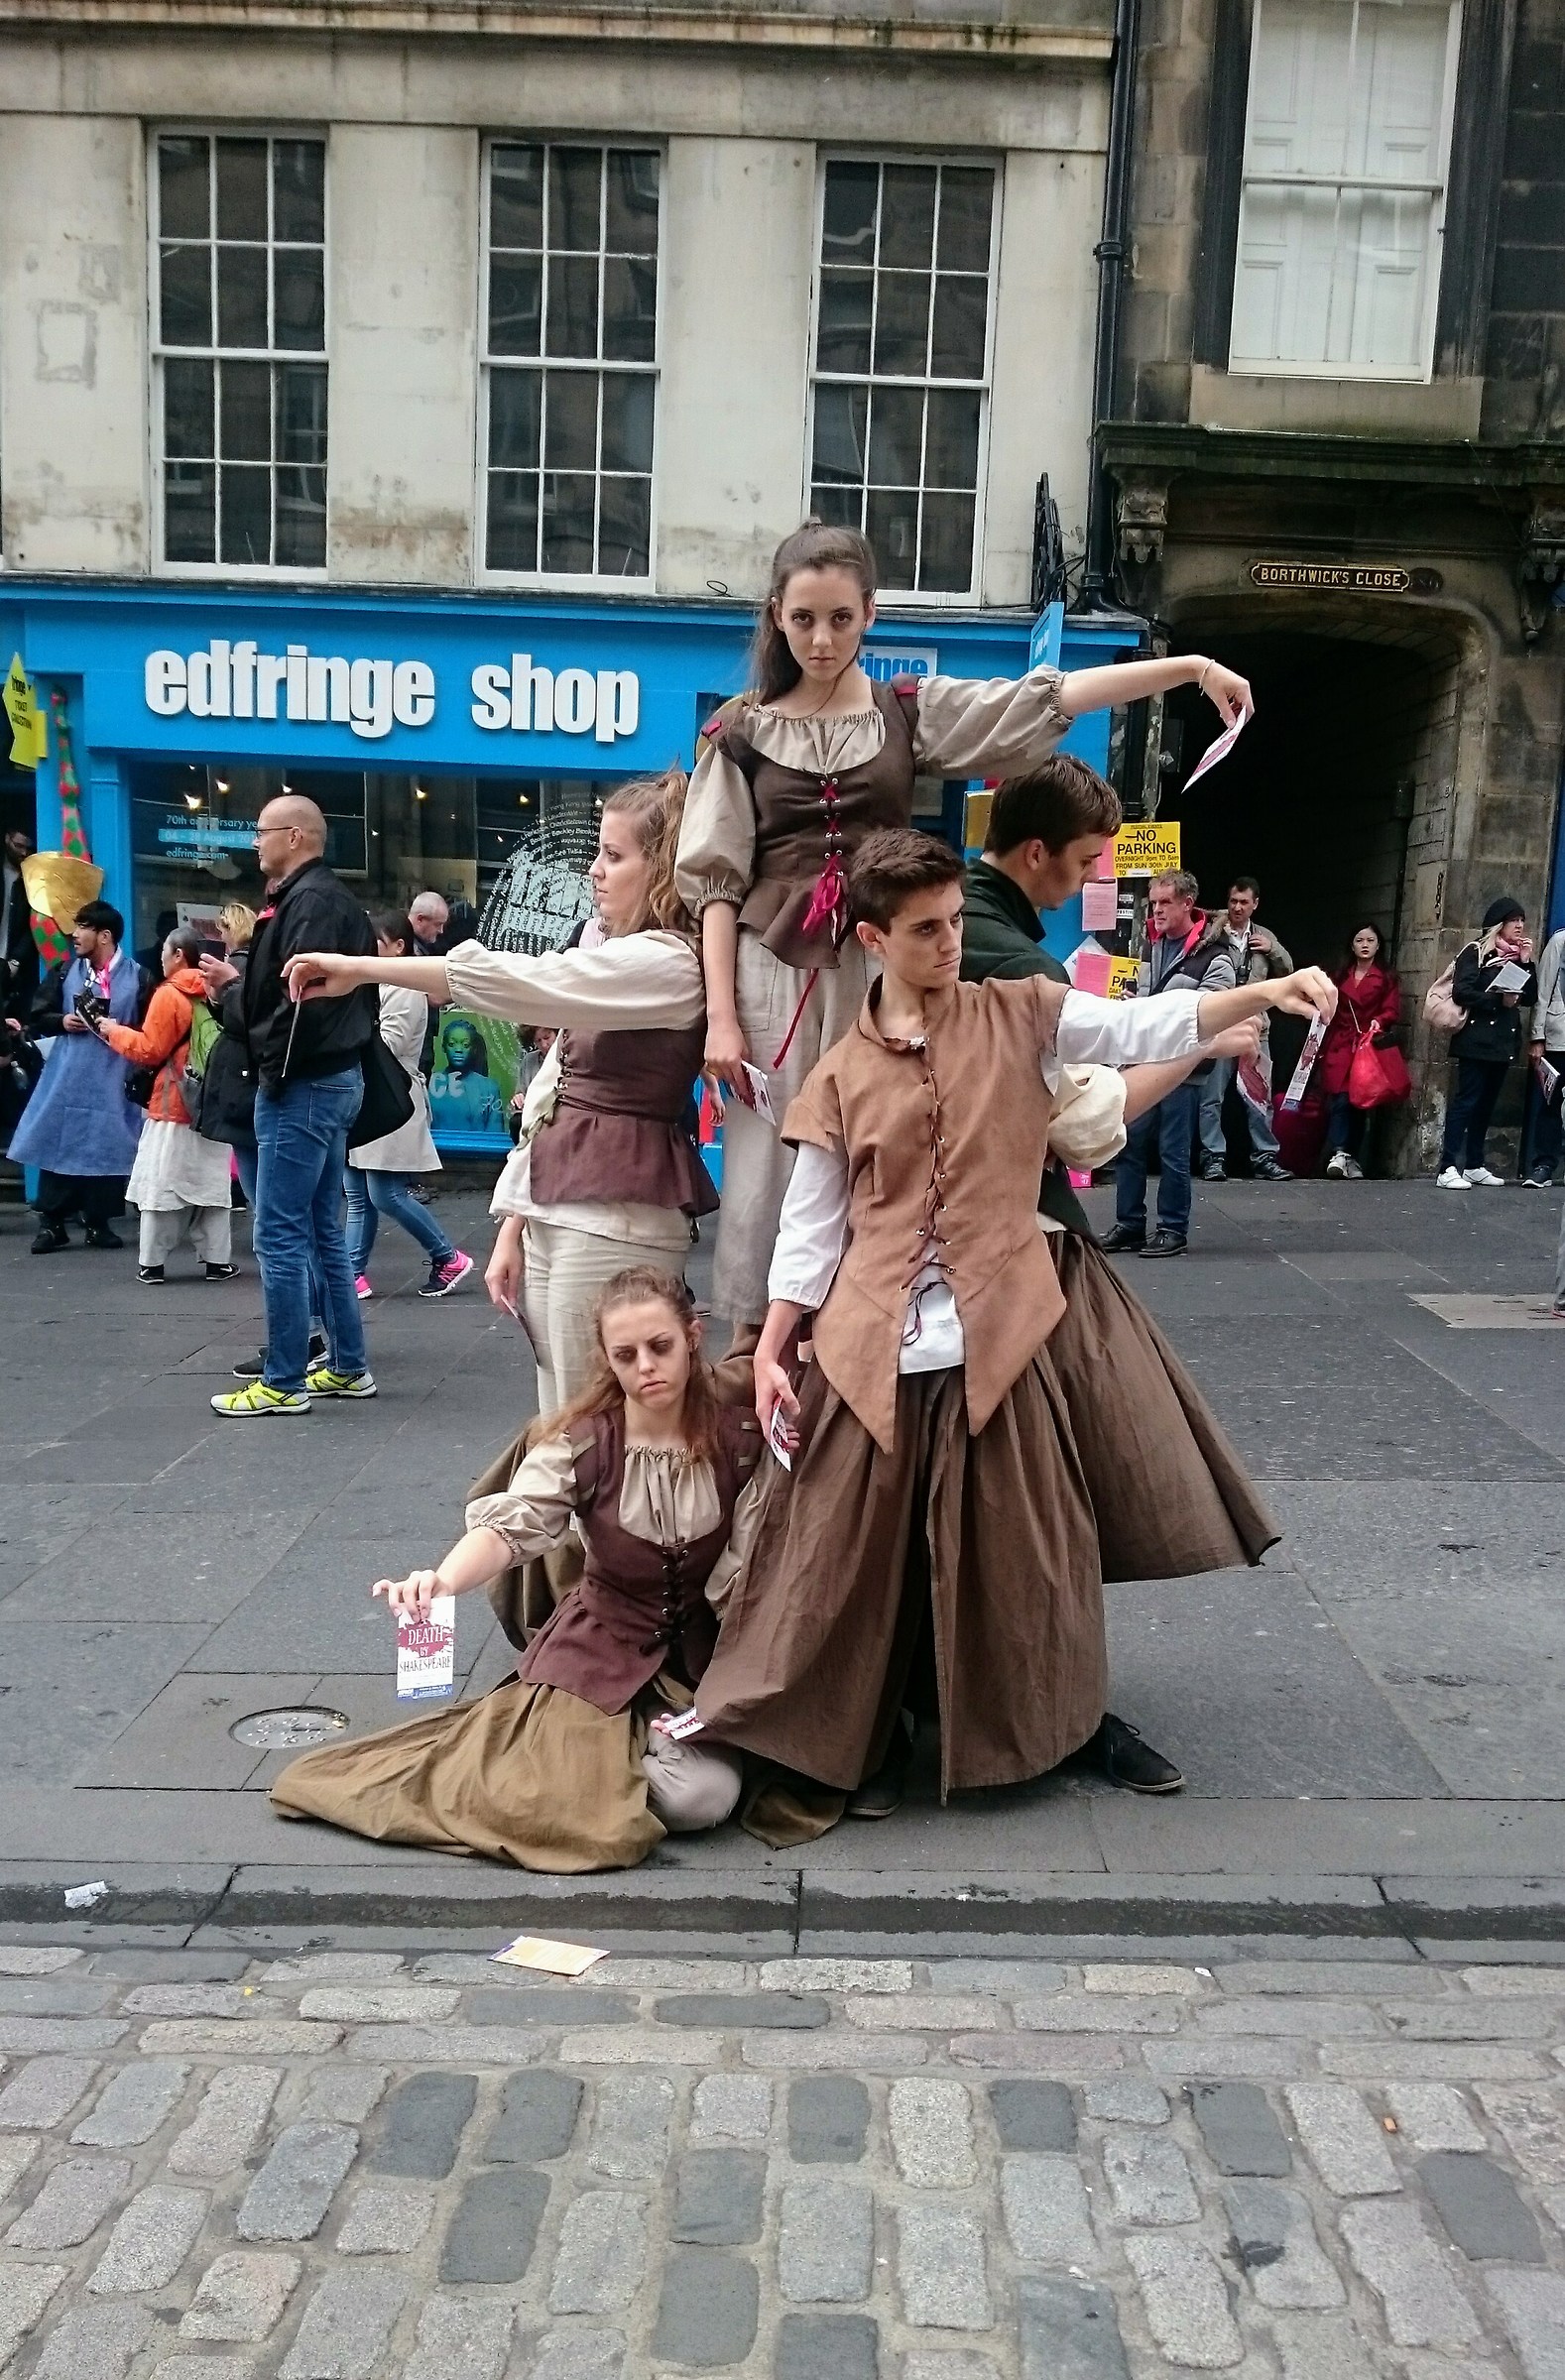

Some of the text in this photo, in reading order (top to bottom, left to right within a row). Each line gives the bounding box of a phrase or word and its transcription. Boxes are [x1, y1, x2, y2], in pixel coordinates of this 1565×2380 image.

[1261, 567, 1401, 587] BORTHWICK'S CLOSE
[859, 653, 928, 682] ringe
[144, 640, 640, 743] edfringe shop
[166, 814, 187, 826] 70th
[203, 833, 235, 845] August
[1137, 830, 1156, 842] NO
[1117, 842, 1176, 855] PARKING
[408, 1625, 444, 1646] DEATH
[420, 1646, 428, 1656] BY
[399, 1656, 451, 1674] SHAKESPEARE
